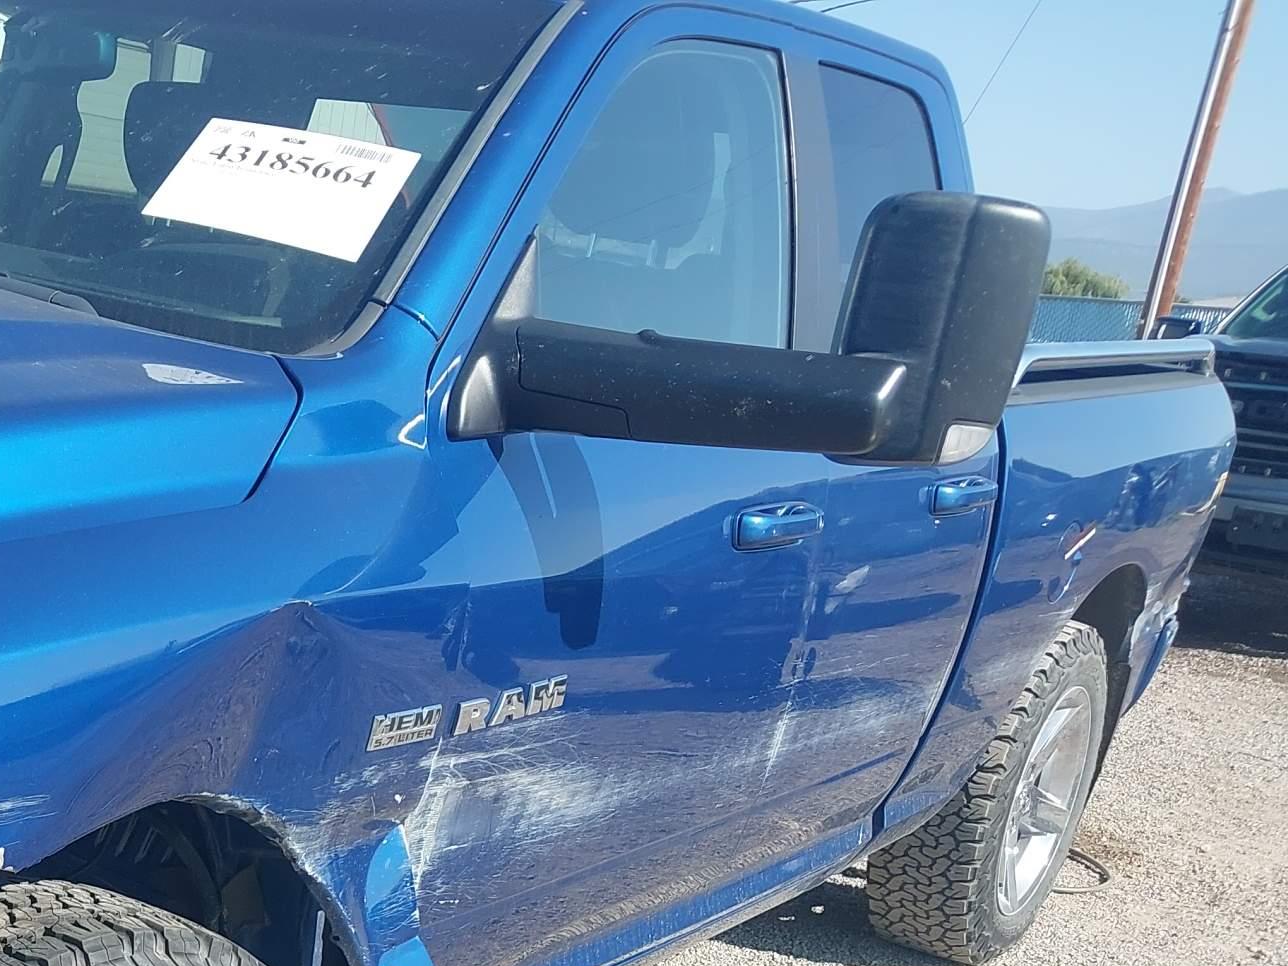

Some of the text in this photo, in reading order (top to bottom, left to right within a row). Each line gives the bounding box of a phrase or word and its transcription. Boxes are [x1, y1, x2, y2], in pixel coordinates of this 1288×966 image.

[210, 143, 376, 188] 43185664
[453, 674, 569, 736] RAM
[397, 728, 433, 743] LITER
